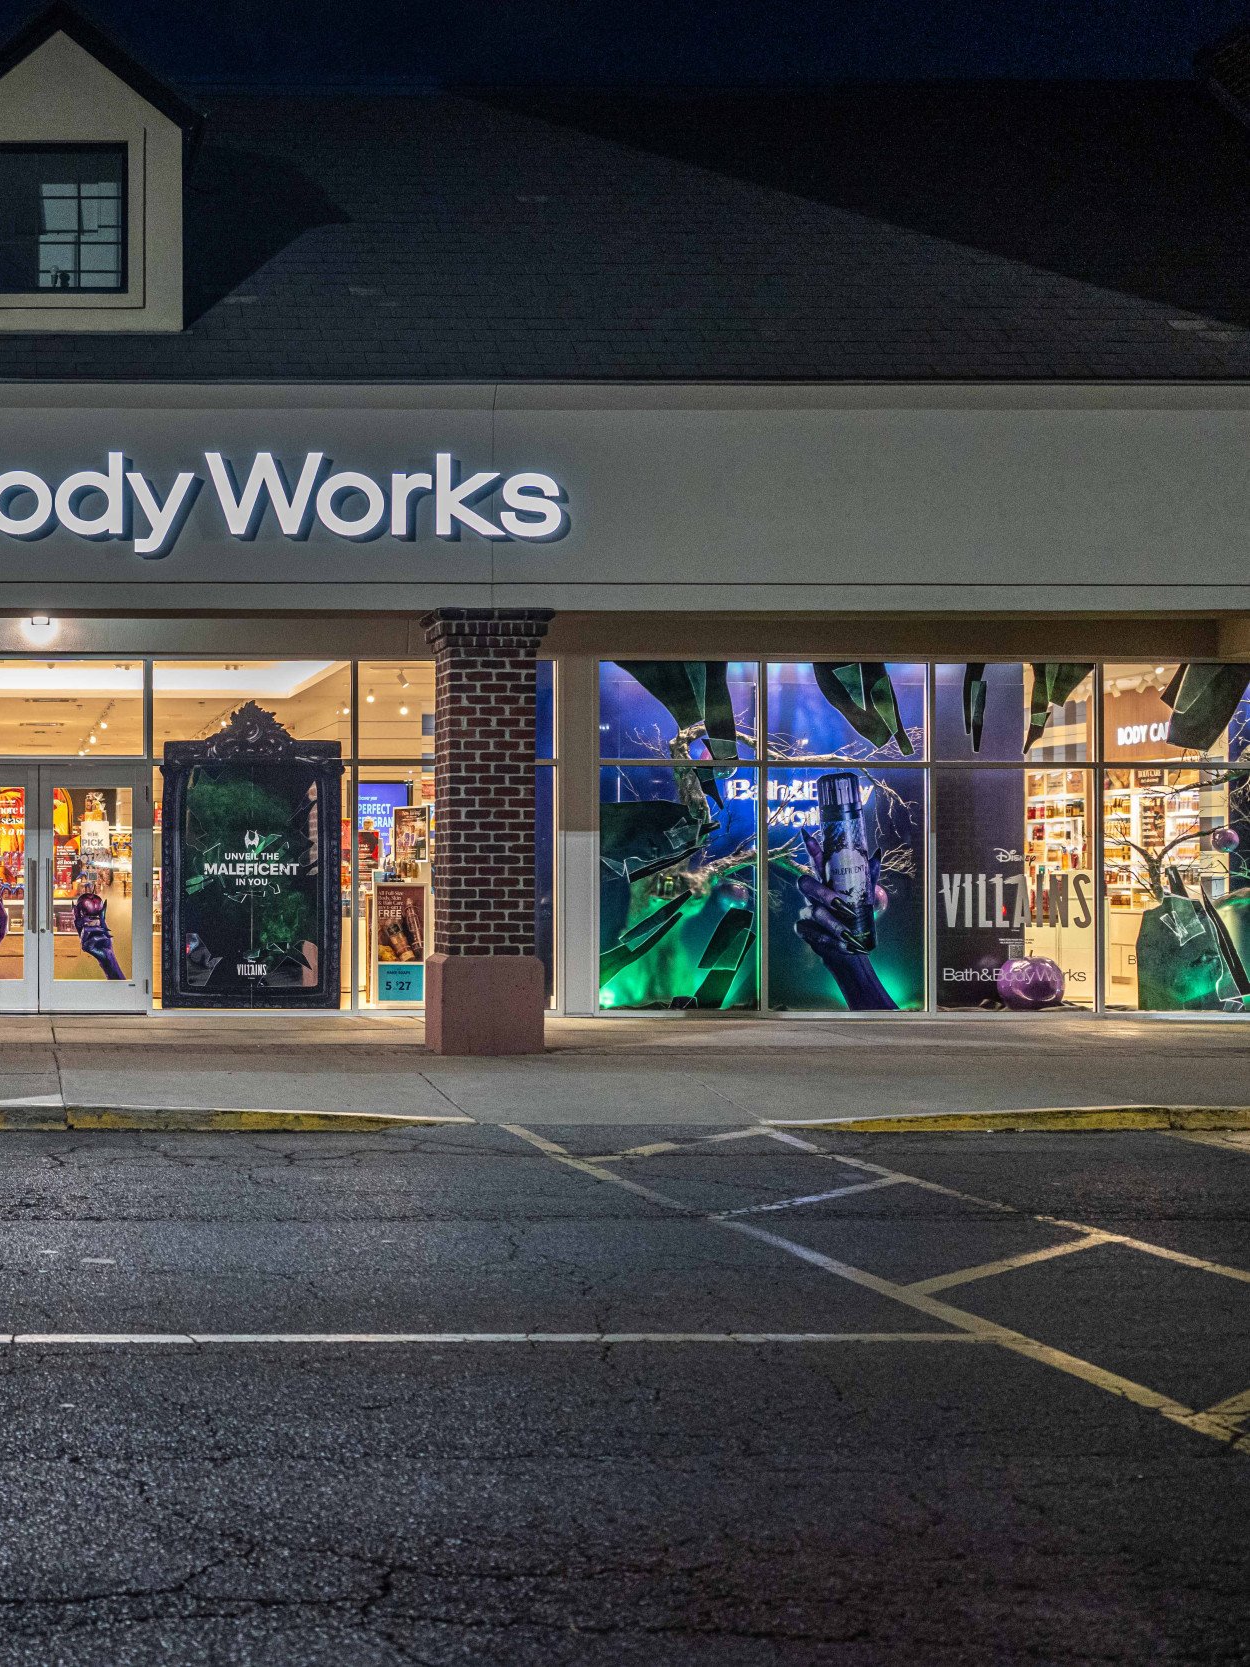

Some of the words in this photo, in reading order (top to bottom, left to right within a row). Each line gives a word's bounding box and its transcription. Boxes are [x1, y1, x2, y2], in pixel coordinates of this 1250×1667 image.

[205, 451, 563, 538] Works
[1117, 724, 1148, 746] BODY
[1149, 721, 1169, 742] CA
[19, 806, 25, 815] t
[358, 803, 391, 815] PERFECT
[224, 852, 258, 860] UNVEIL
[260, 852, 280, 860] THE
[993, 847, 1037, 867] Disney
[203, 863, 300, 876] MALEFICENT
[235, 878, 246, 886] IN
[248, 878, 268, 886] YOU
[938, 873, 1092, 929] VILLAINS
[378, 909, 402, 918] FREE
[236, 964, 267, 976] VILLAINS
[1033, 968, 1087, 982] Works
[385, 982, 392, 991] 5
[395, 981, 412, 991] $27
